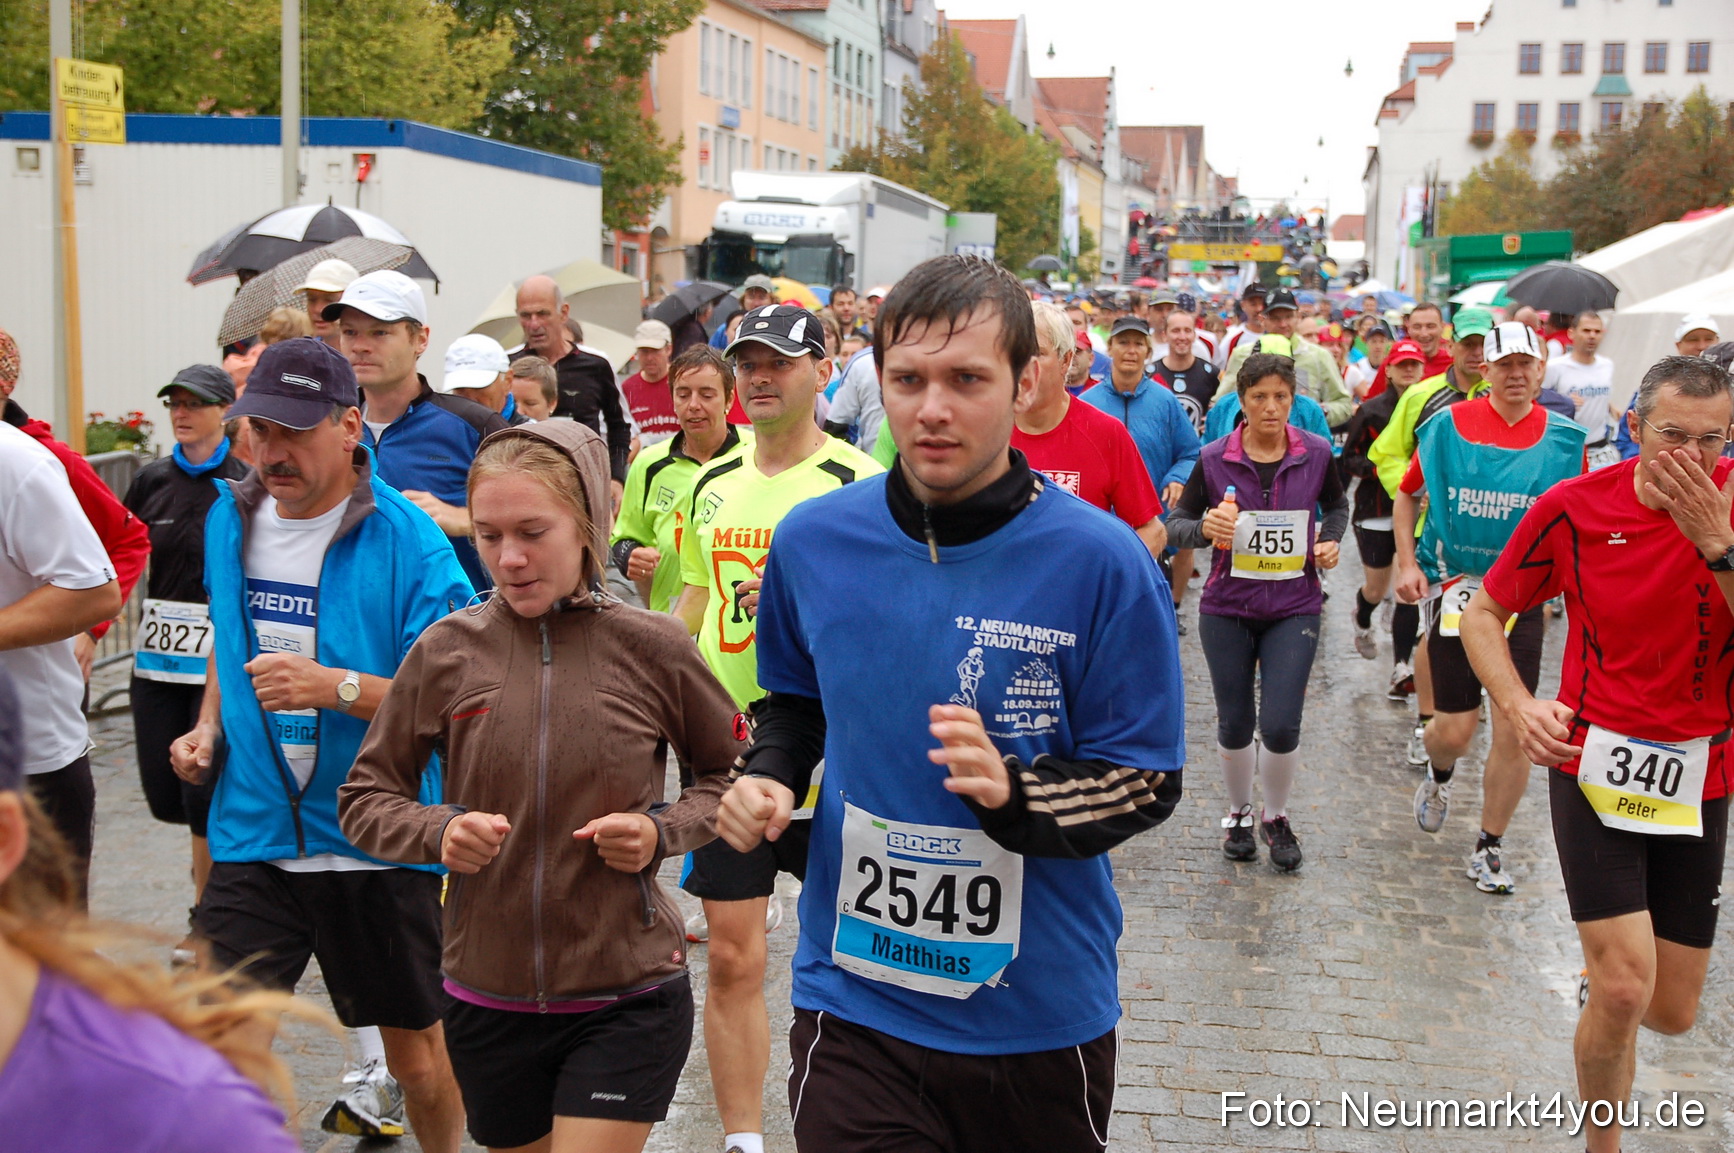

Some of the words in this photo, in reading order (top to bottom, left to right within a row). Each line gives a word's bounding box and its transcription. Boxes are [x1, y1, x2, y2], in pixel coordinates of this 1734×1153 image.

[1458, 501, 1513, 520] POINT
[712, 527, 772, 549] Müll
[1248, 530, 1293, 554] 455
[1258, 560, 1282, 570] Anna
[247, 590, 317, 617] AEDTL
[1458, 591, 1471, 612] 3
[144, 621, 209, 653] 2827
[955, 616, 978, 631] 12.
[979, 618, 1077, 647] NEUMARKTER
[1694, 583, 1711, 702] VELBURG
[258, 635, 302, 653] BOCK
[973, 632, 1057, 656] STADTLAUF
[1002, 699, 1061, 710] 18.09.2011
[1606, 746, 1684, 797] 340
[1616, 797, 1658, 819] Peter
[887, 832, 962, 855] BOCK
[854, 856, 1002, 936] 2549
[871, 933, 971, 976] Matthias
